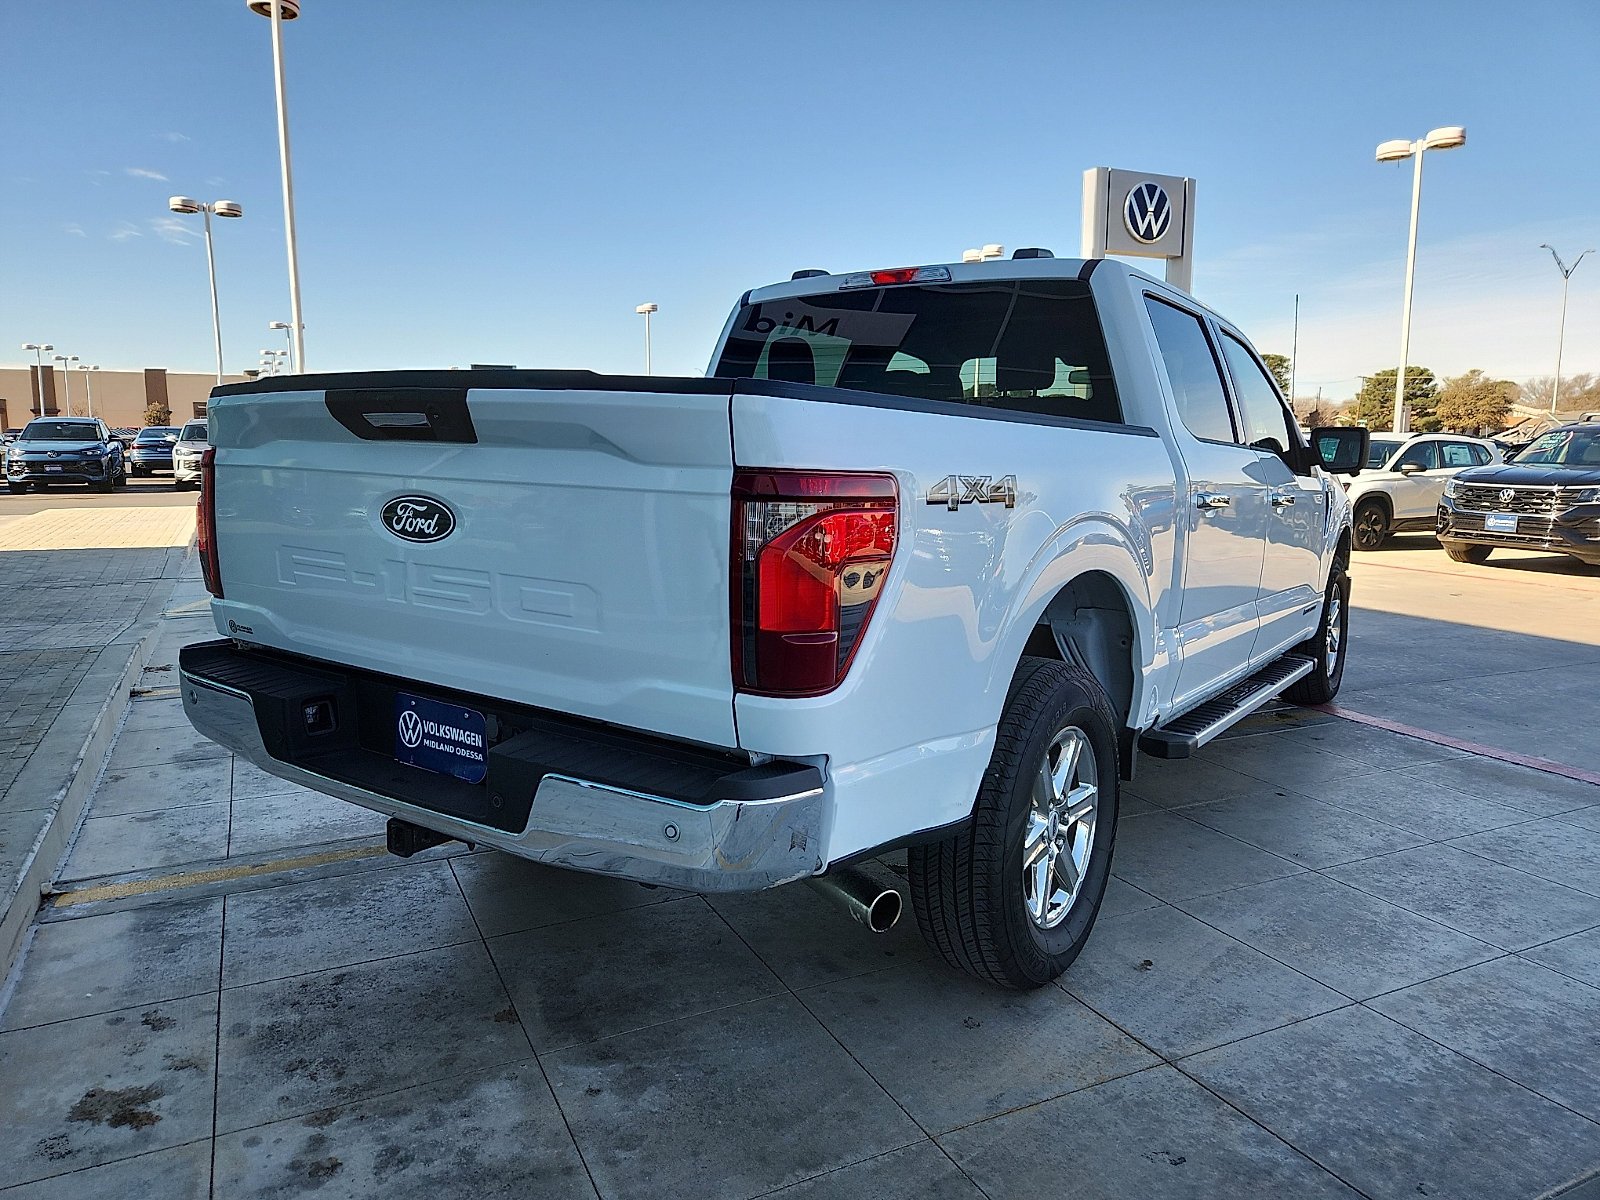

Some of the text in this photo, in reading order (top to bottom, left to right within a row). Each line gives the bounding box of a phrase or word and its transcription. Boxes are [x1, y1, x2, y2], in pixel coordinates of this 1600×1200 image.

[393, 502, 440, 535] Ford
[276, 544, 601, 633] F-150
[423, 720, 482, 747] VOLKSWAGEN
[423, 739, 484, 762] MIDLAND ODESSA
